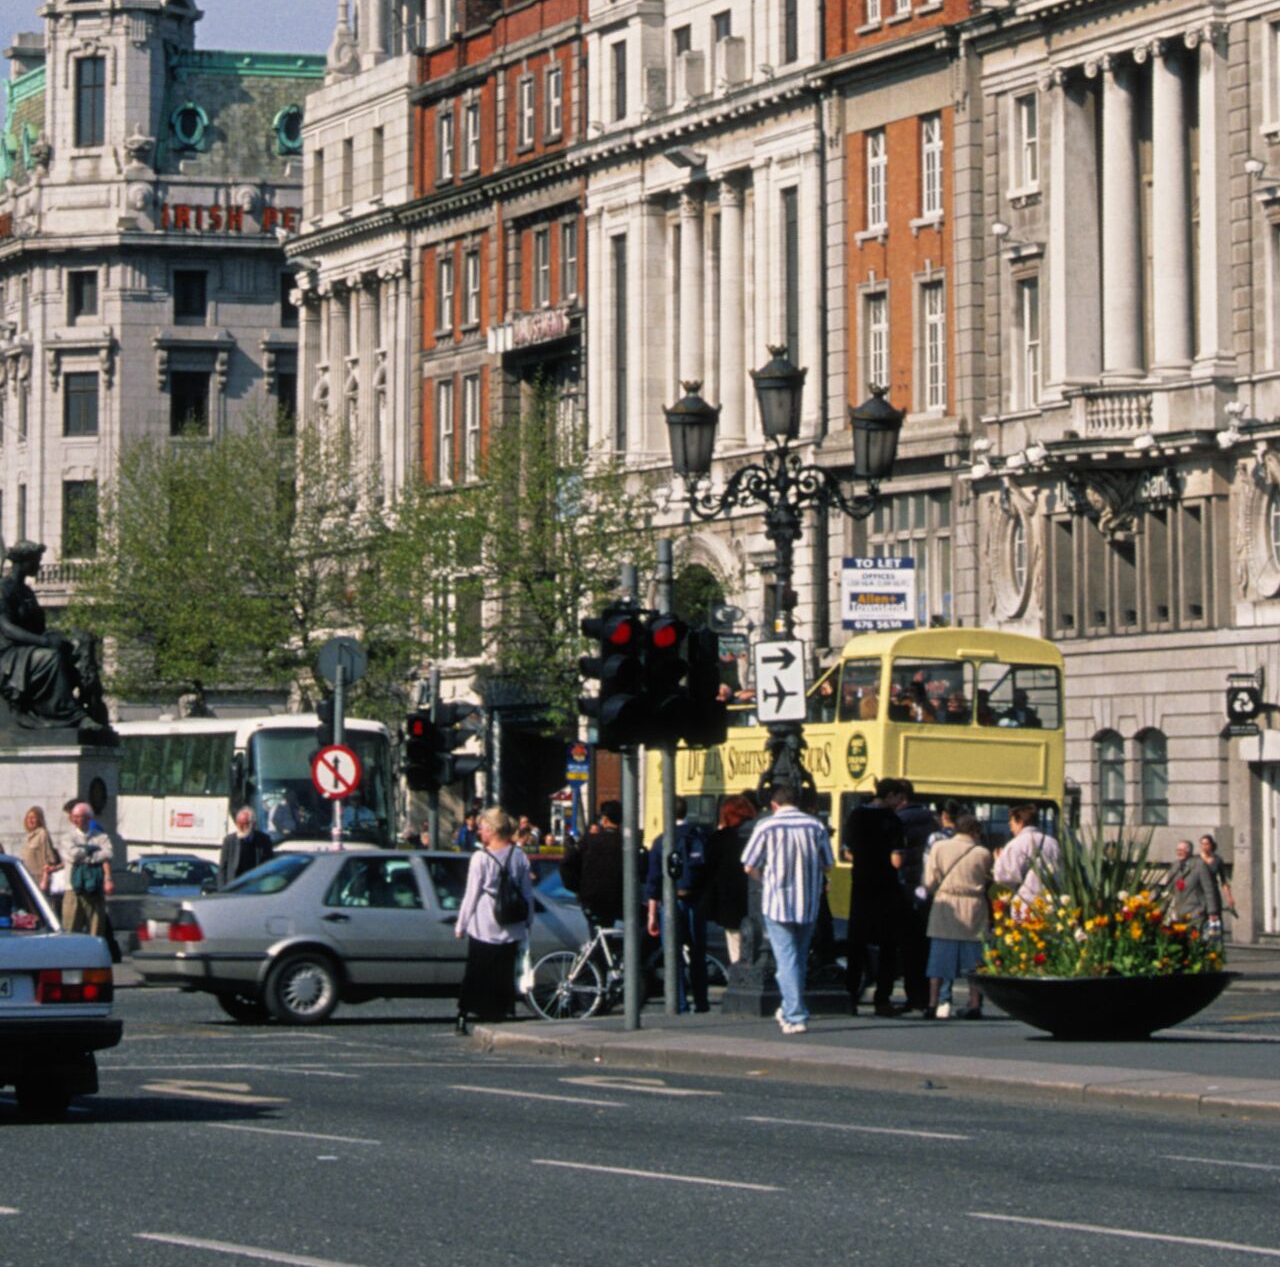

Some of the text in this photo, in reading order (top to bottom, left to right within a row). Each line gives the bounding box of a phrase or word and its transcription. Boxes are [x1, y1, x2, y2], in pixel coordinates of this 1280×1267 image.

[161, 204, 244, 232] IRISH
[854, 558, 902, 569] TO LET
